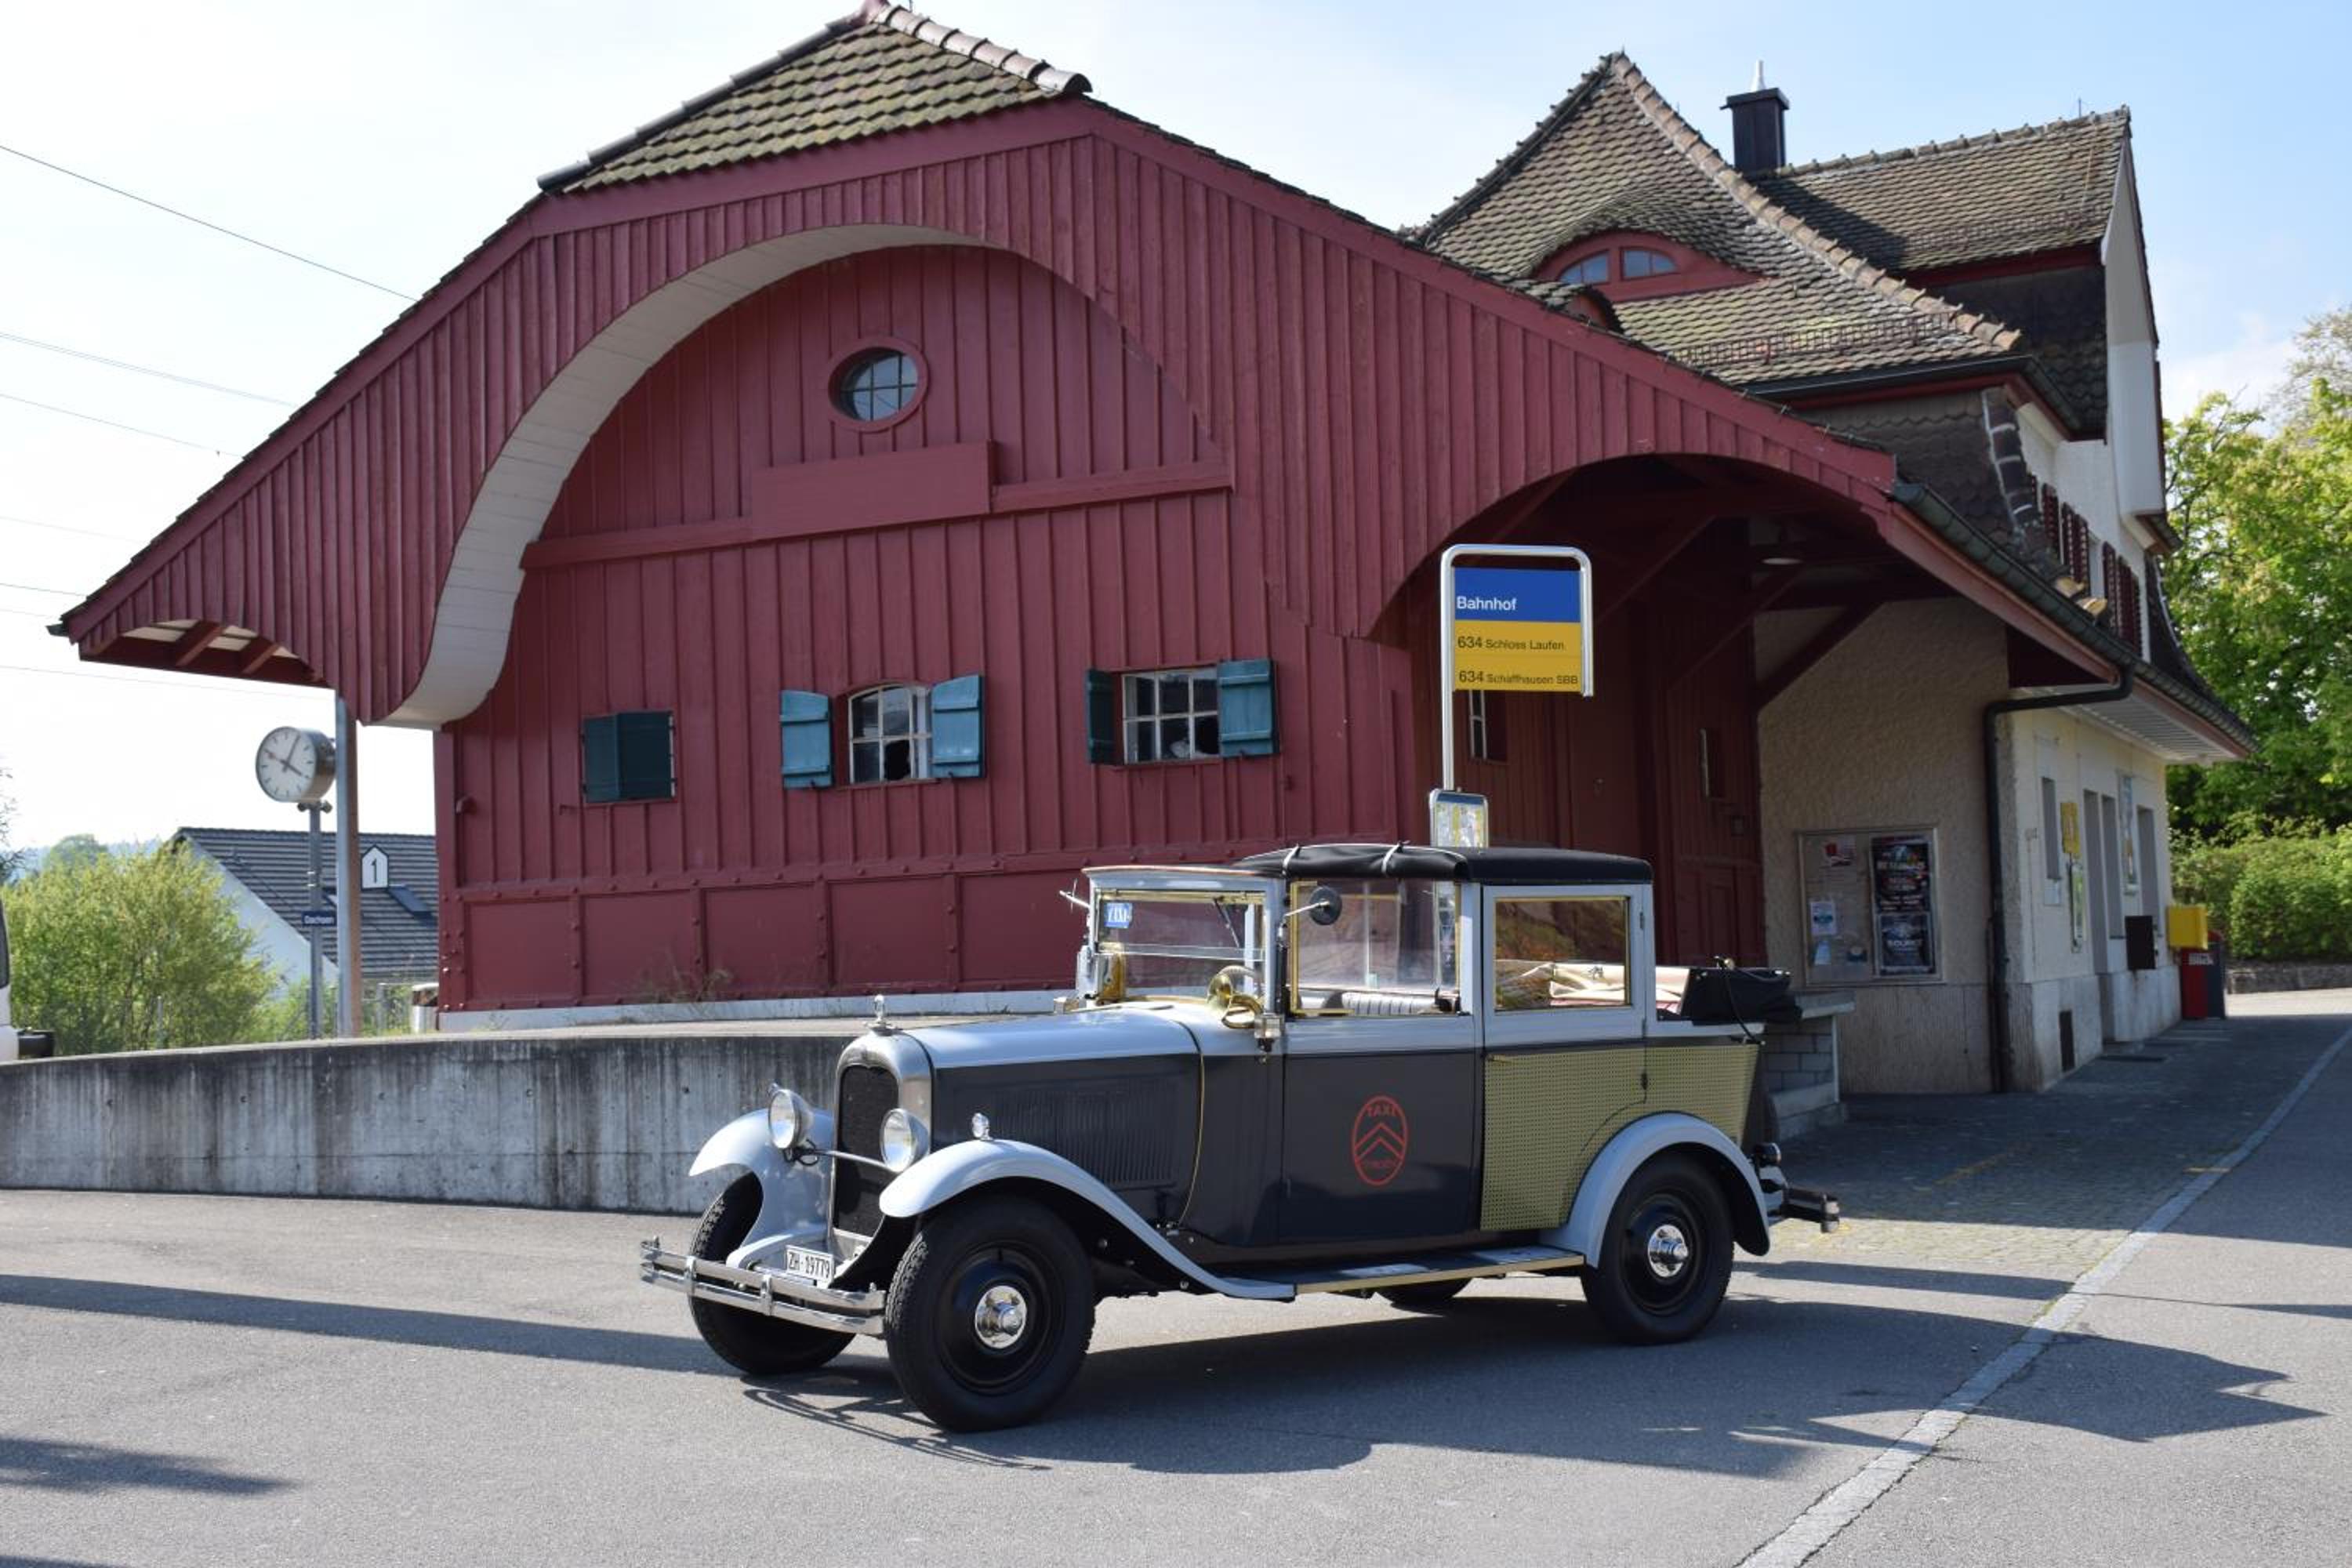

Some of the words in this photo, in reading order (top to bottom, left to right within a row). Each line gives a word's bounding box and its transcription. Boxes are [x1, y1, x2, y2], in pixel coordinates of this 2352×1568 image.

[1456, 596, 1517, 611] Bahnhof
[1457, 636, 1483, 648] 634
[1486, 639, 1526, 650] Schloss
[1530, 640, 1564, 650] Laufen
[1459, 670, 1483, 683] 634
[1486, 673, 1553, 684] Schaffhausen
[1556, 675, 1578, 684] SBB
